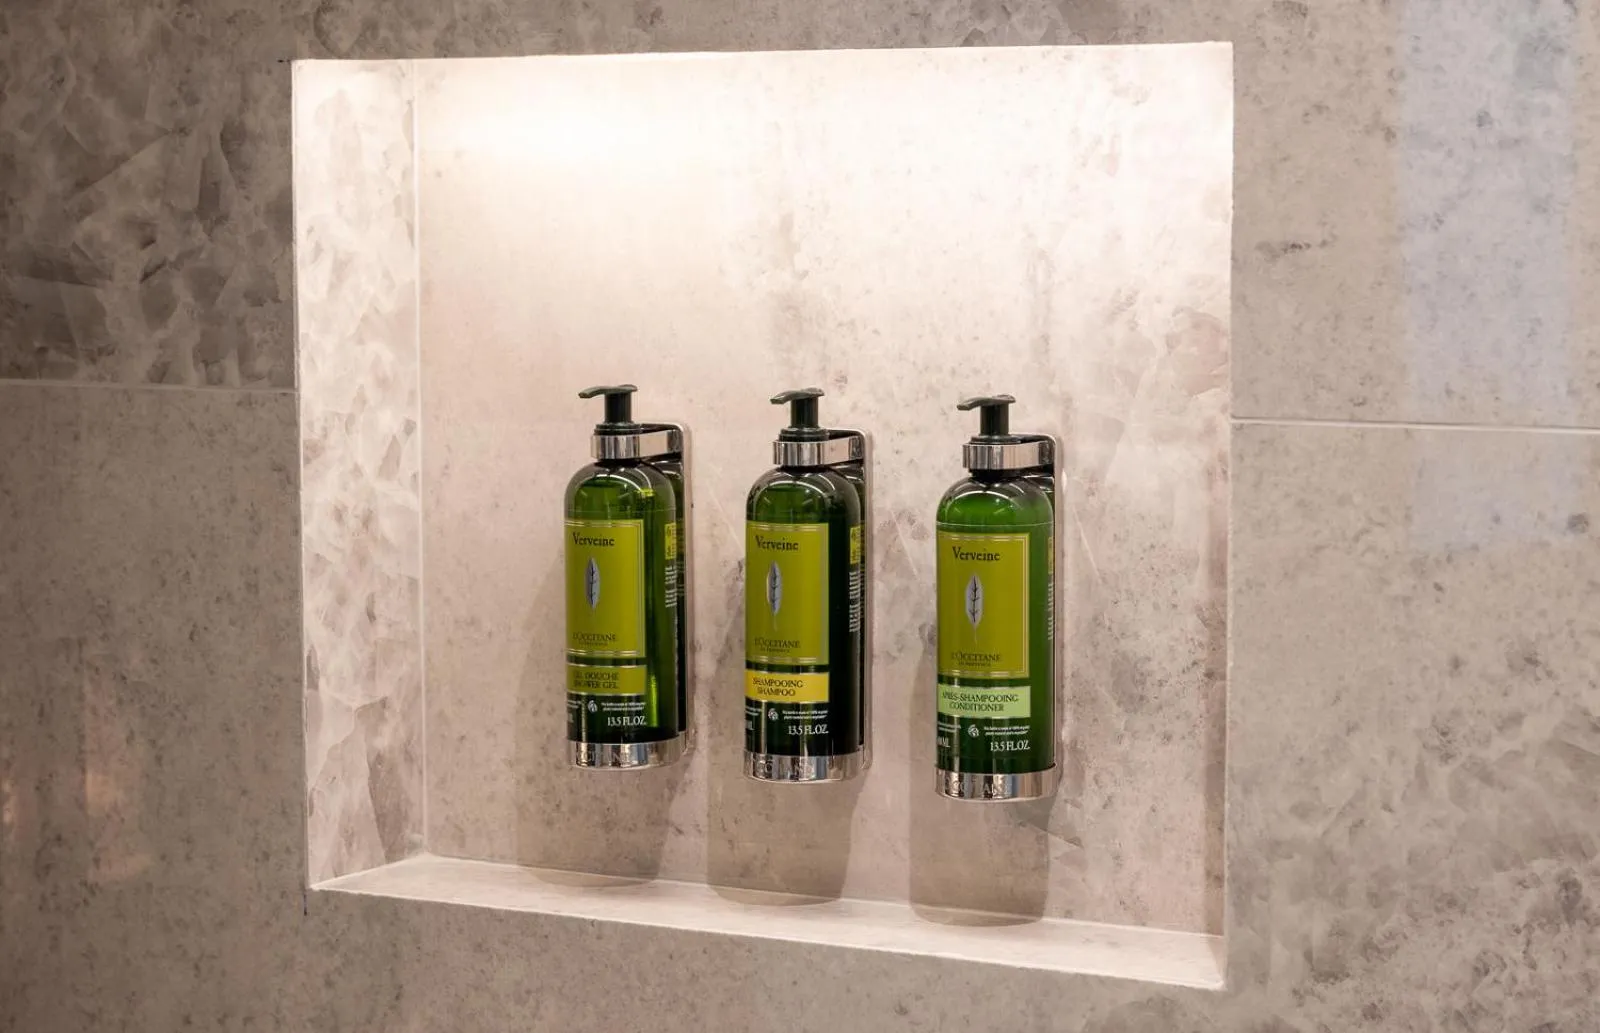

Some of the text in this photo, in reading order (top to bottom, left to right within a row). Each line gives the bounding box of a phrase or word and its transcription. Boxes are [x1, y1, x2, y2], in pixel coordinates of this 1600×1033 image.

[573, 532, 616, 547] Verveine
[755, 535, 800, 551] Verveine
[952, 546, 1001, 561] Verveine
[752, 676, 804, 689] SHAMPOOING
[757, 687, 796, 697] SHAMPOO
[949, 701, 1005, 713] CONDITIONER
